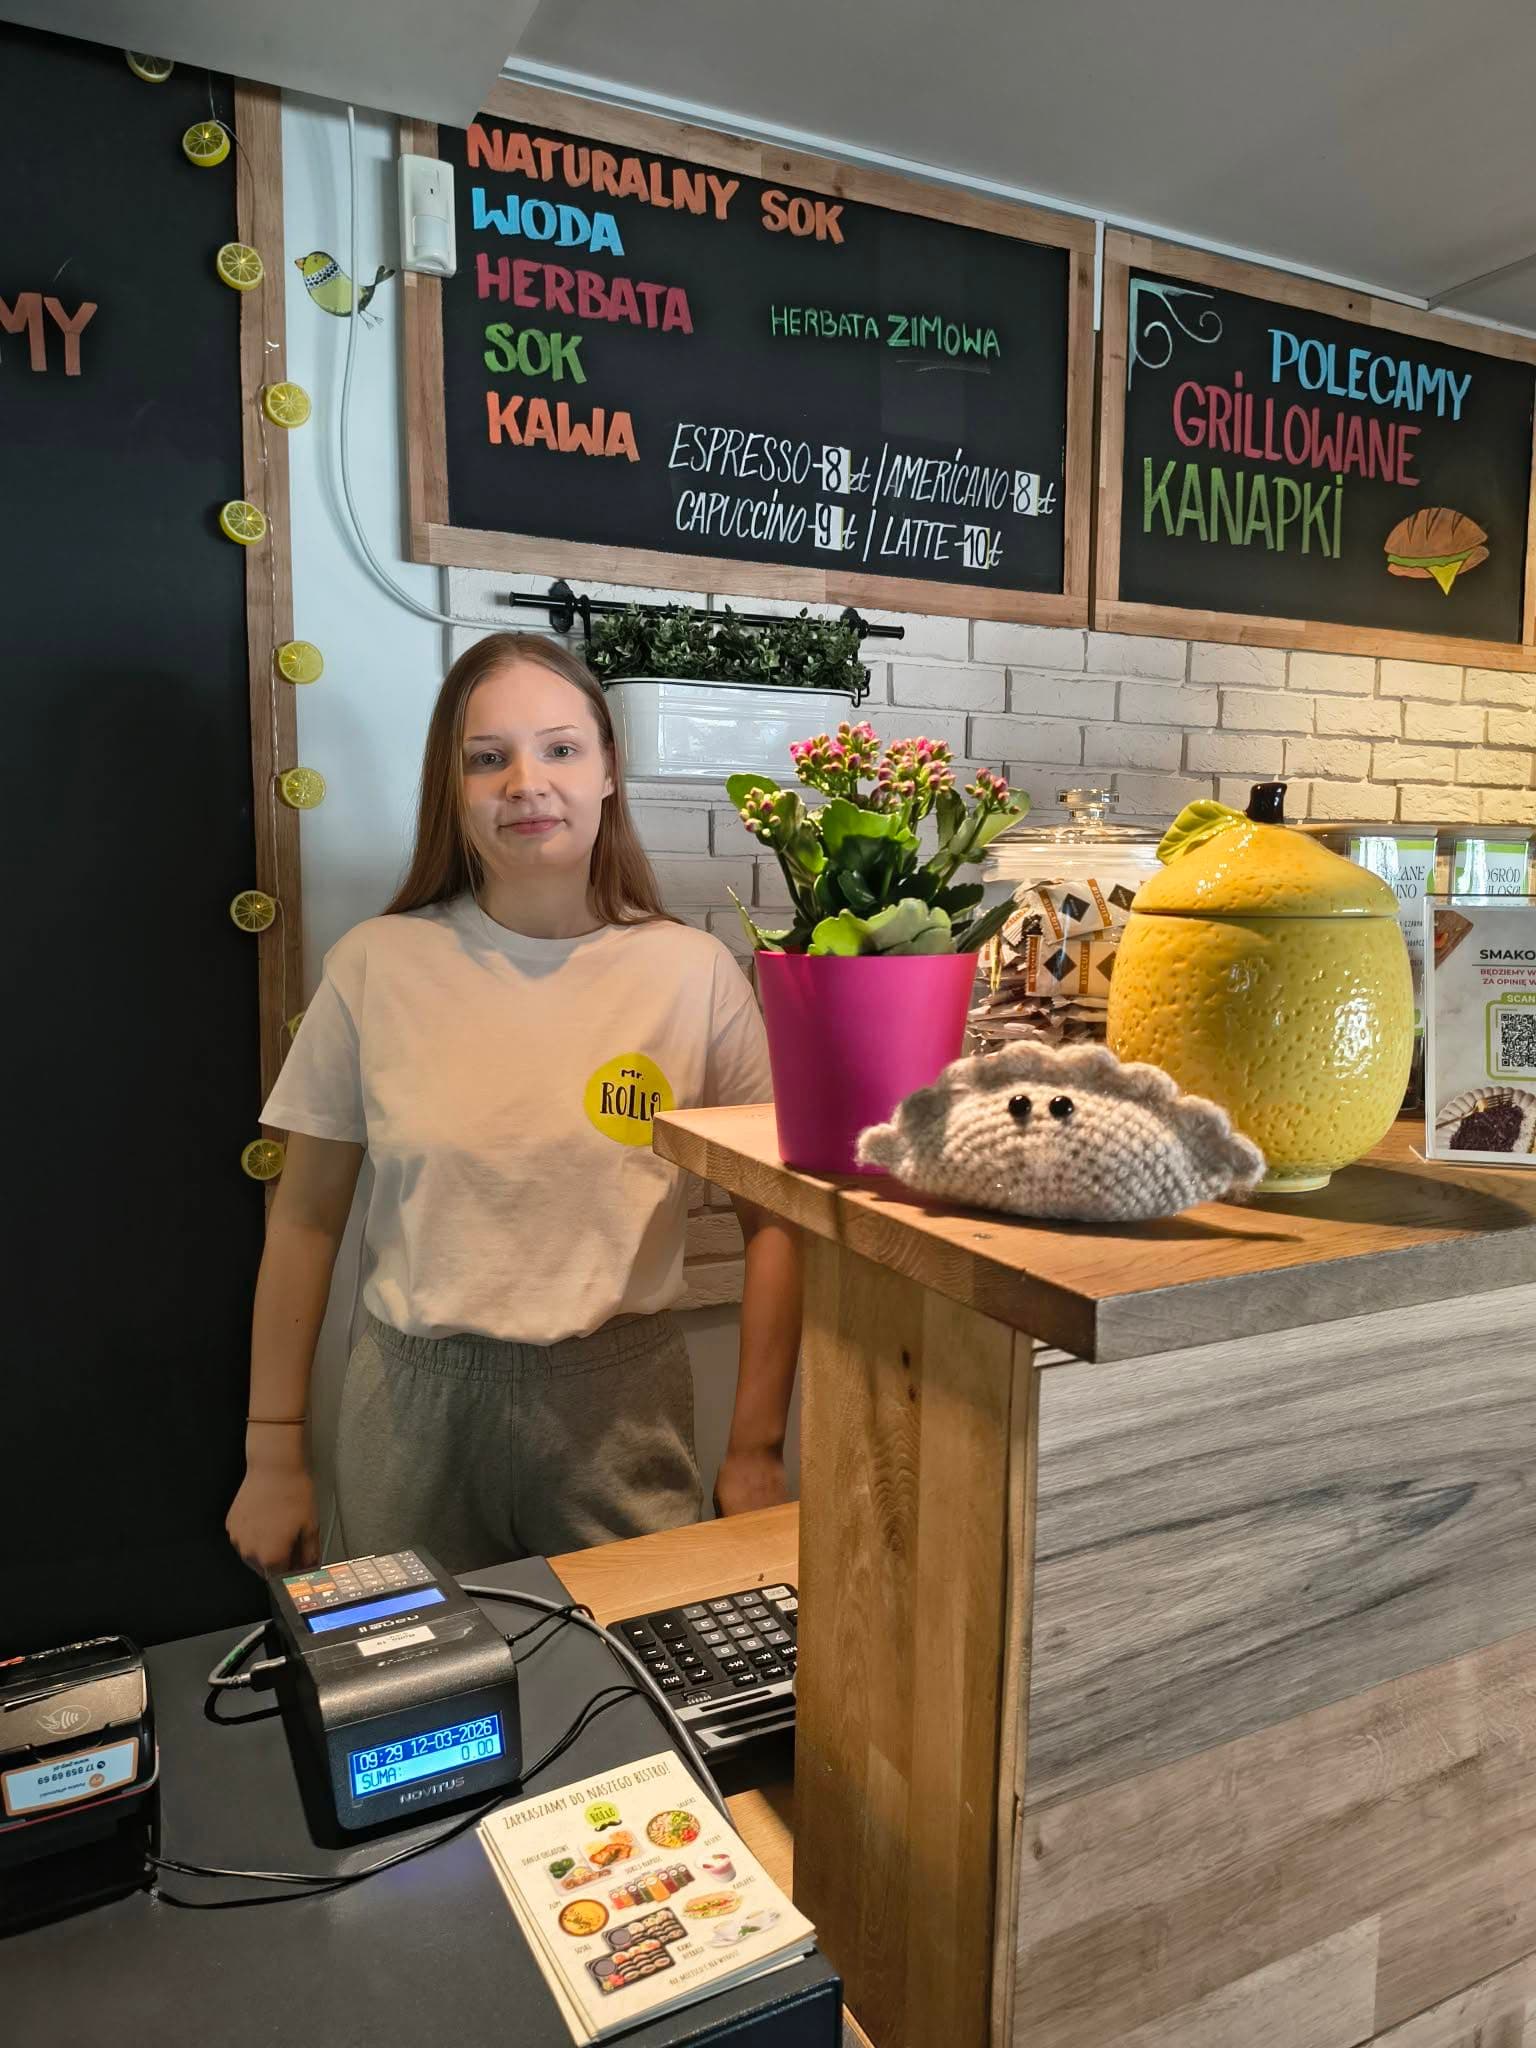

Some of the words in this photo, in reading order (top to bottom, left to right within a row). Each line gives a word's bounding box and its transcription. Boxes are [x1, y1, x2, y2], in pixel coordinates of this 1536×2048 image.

[466, 123, 739, 220] NATURALNY
[761, 189, 844, 243] SOK
[472, 187, 625, 256] WODA
[475, 253, 694, 334] HERBATA
[484, 323, 587, 384] SOK
[771, 305, 879, 339] HERBATA
[886, 314, 1000, 357] ZIMOWA
[1267, 329, 1472, 421] POLECAMY
[486, 392, 640, 462] KAWA
[668, 423, 811, 484] ESPRESSO
[880, 516, 957, 560] LATTE
[1480, 968, 1525, 977] BĘDZIEMY
[1507, 994, 1535, 1003] SCAN
[621, 1069, 644, 1080] Mr.
[360, 1746, 402, 1769] 09:29
[411, 1720, 492, 1755] 12-03-2026
[362, 1766, 402, 1790] SUMA:
[400, 1776, 465, 1803] NOVITUS
[502, 1798, 568, 1829] ZAPRASZAMY
[569, 1793, 585, 1806] DO
[587, 1776, 633, 1800] NASZEGO
[633, 1762, 671, 1784] BISTRO!
